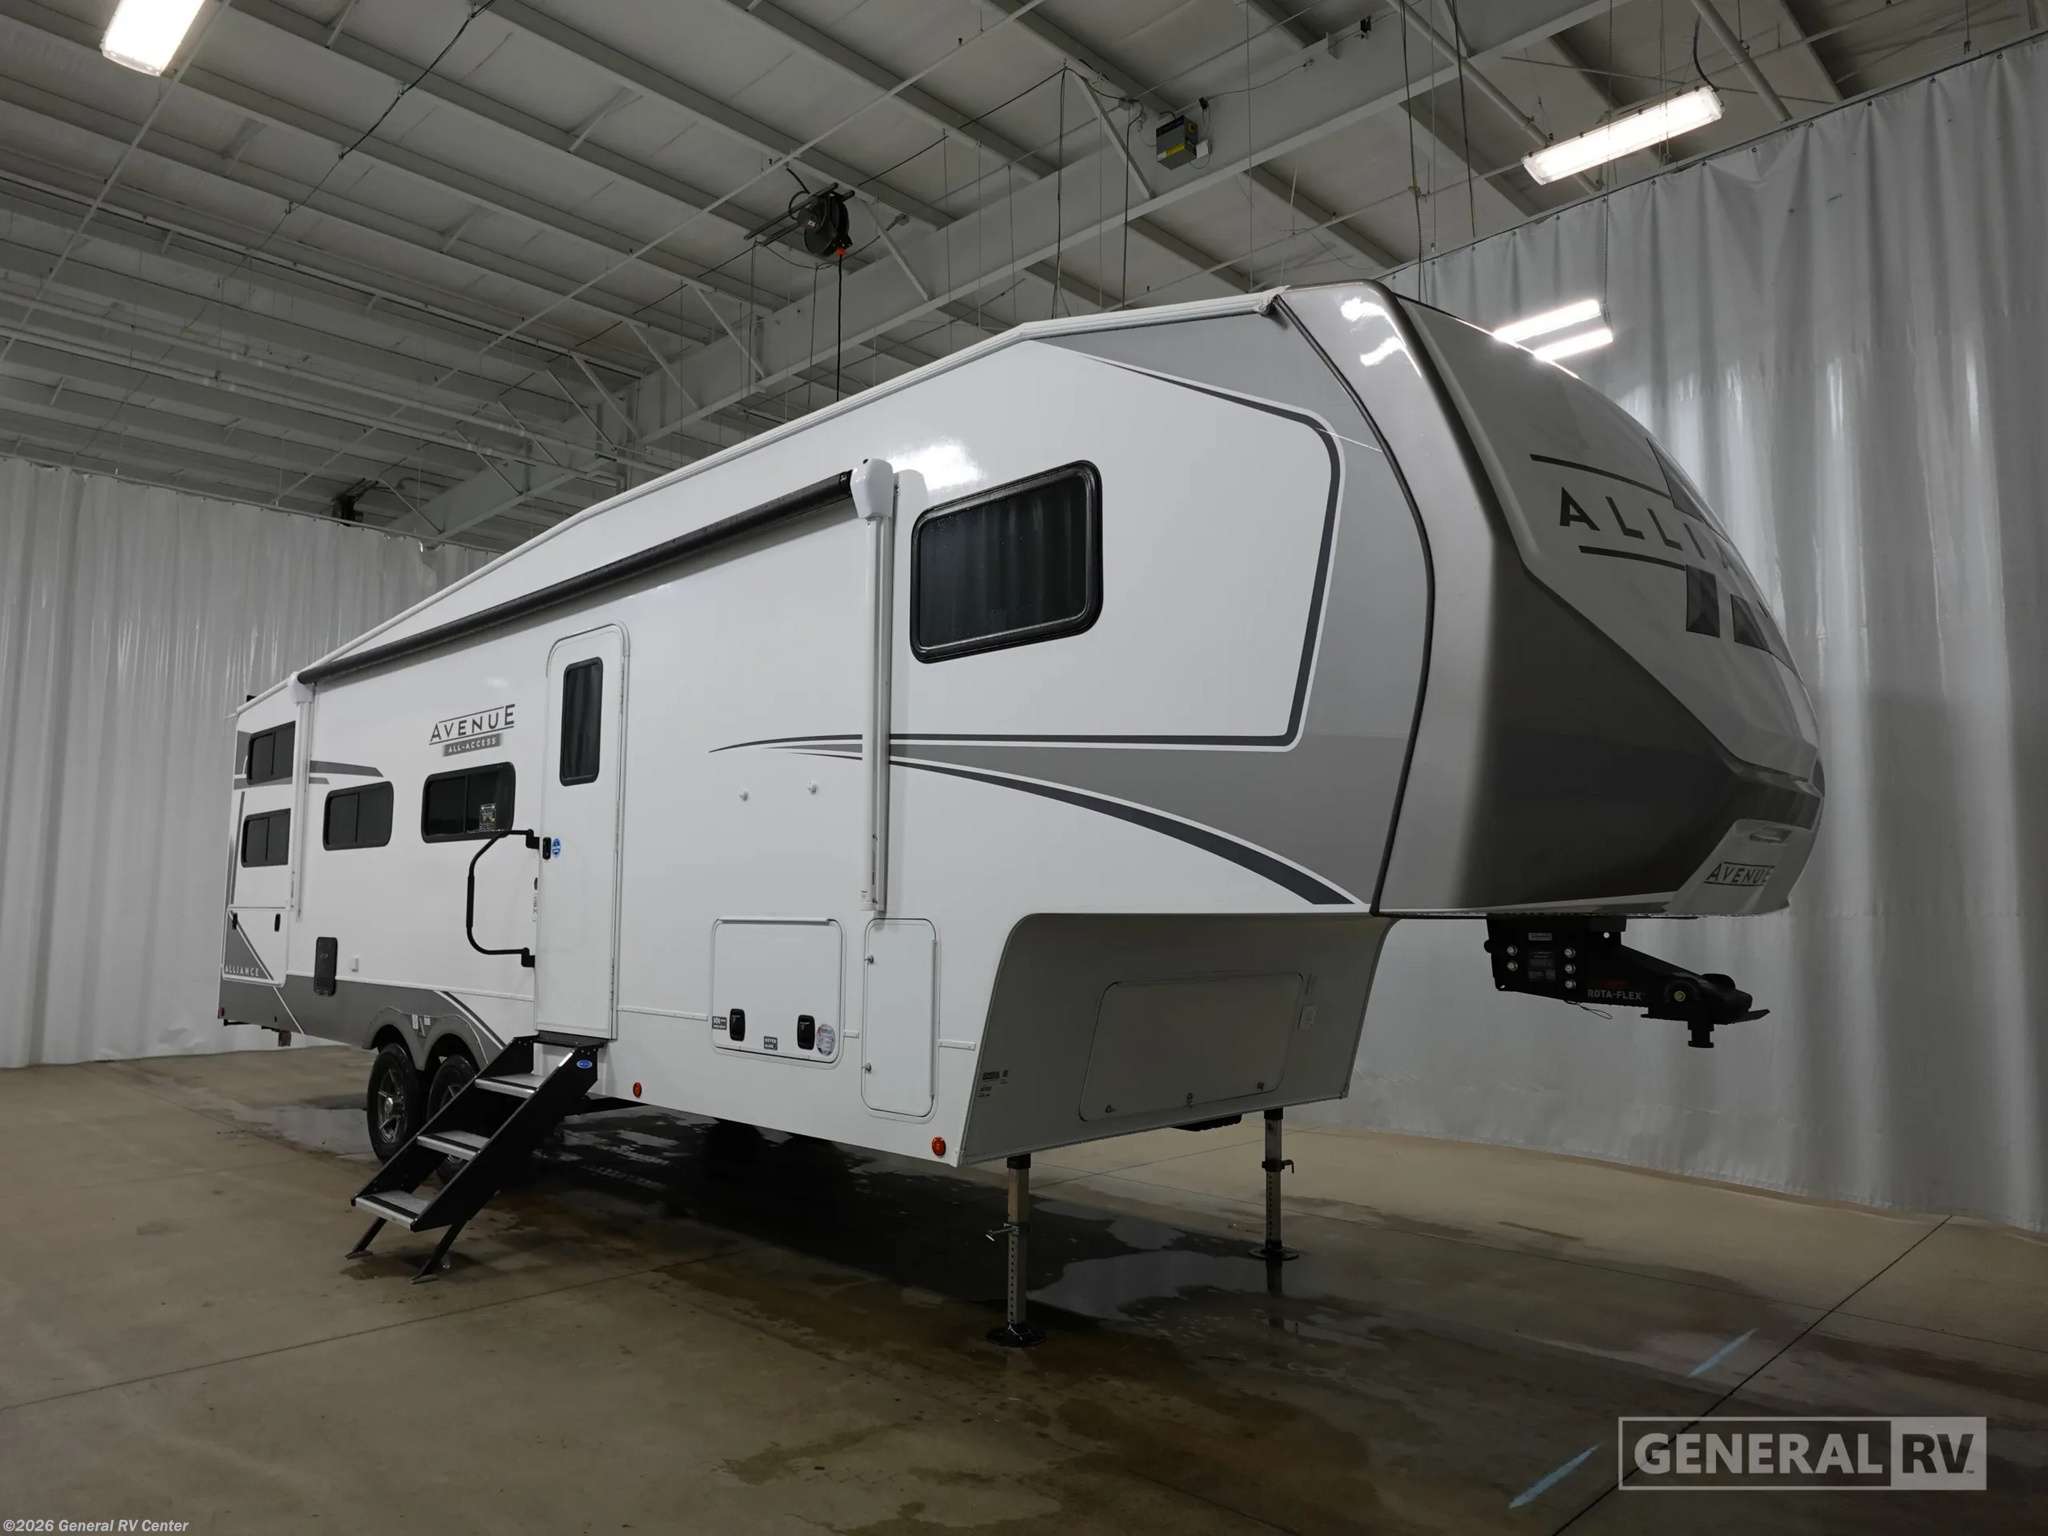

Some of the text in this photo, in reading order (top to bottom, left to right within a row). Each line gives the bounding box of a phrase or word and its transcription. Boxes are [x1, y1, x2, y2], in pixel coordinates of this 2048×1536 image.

[430, 703, 515, 742] AVENUE
[448, 737, 497, 754] ALL-ACCESS
[1705, 862, 1775, 884] AVENUE
[225, 964, 259, 977] ALLIANCE
[1587, 988, 1642, 1001] ROTA-FLEX
